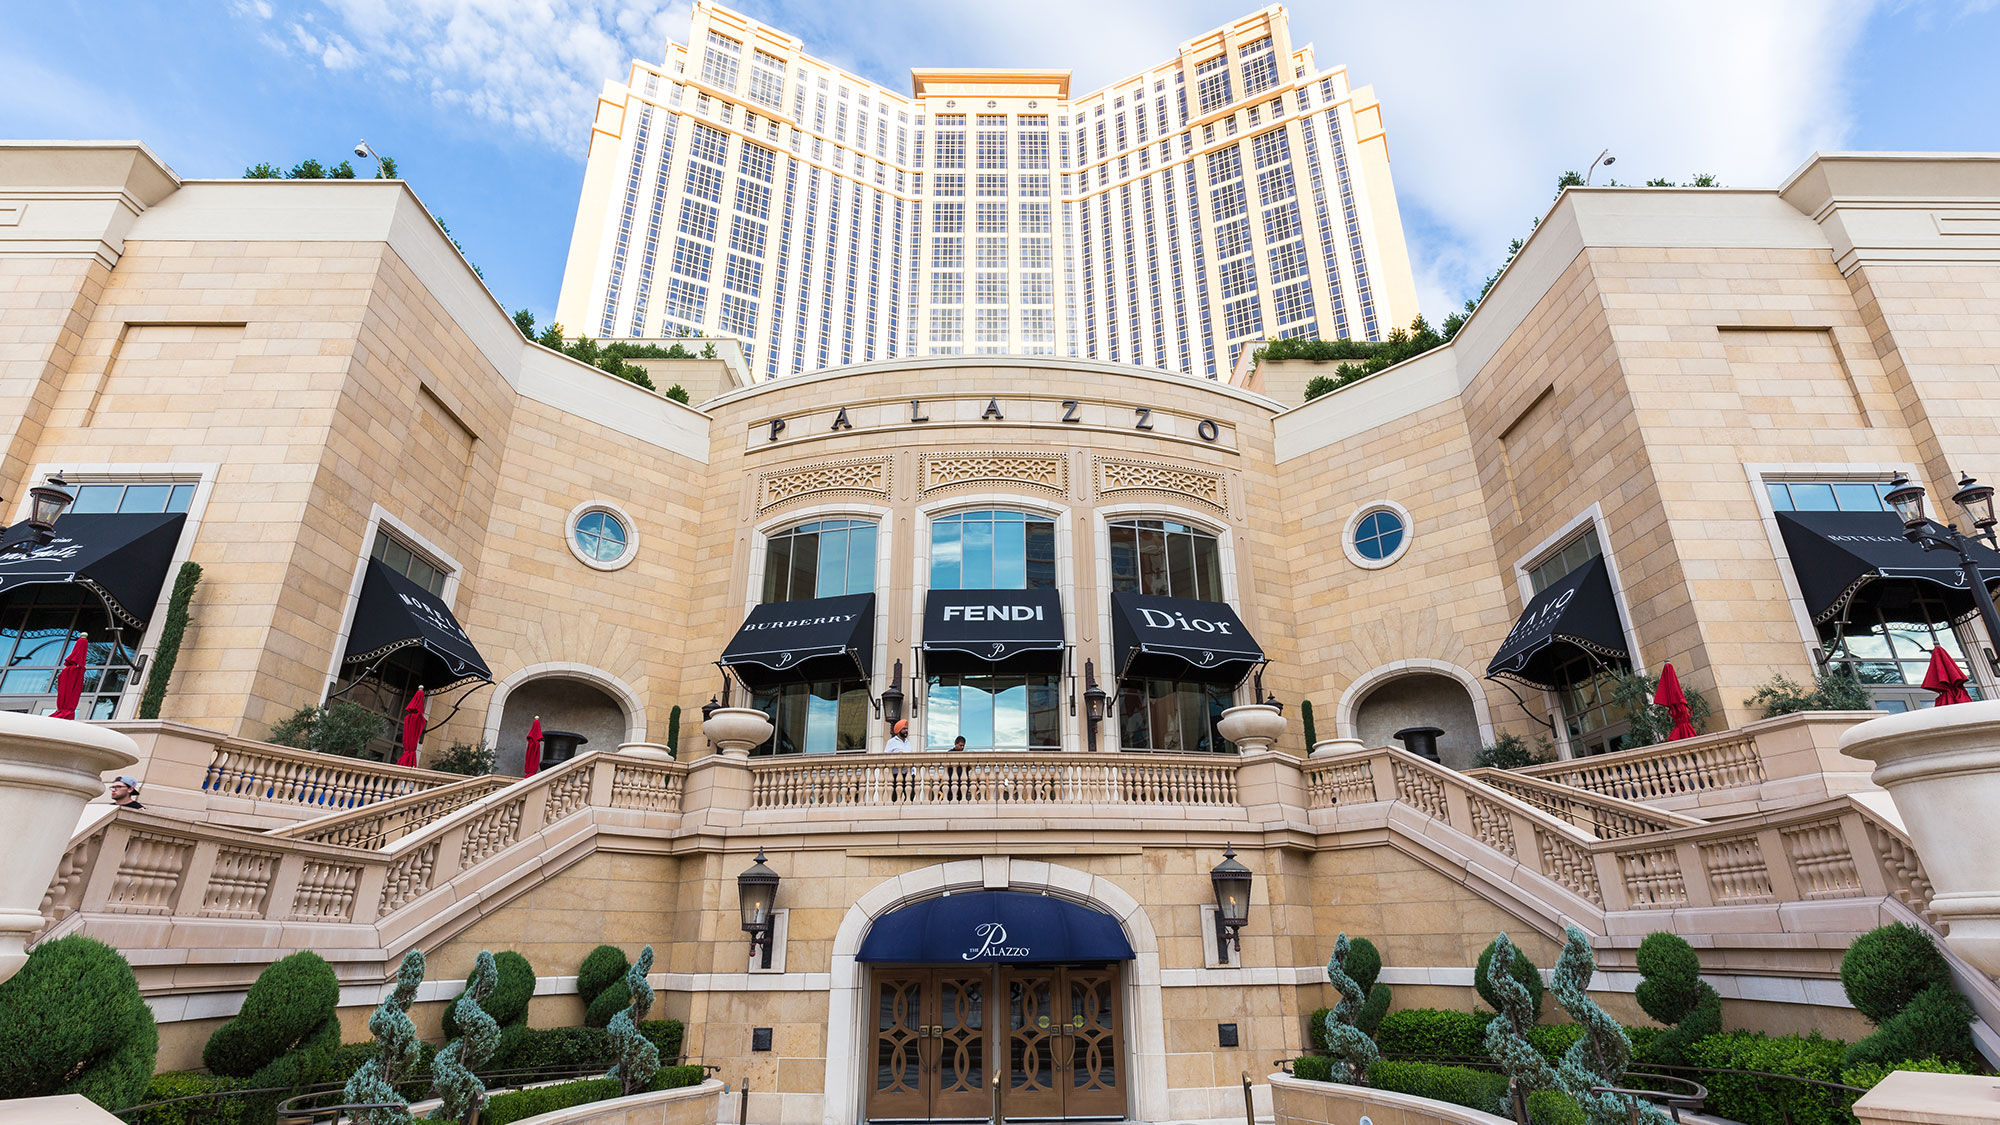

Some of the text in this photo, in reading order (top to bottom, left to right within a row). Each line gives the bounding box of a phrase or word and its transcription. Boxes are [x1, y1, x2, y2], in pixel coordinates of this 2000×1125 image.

[944, 84, 1040, 94] PALAZZO
[768, 397, 1219, 442] PALAZZO
[1828, 534, 1902, 543] BOTTEGA
[743, 613, 857, 632] BURBERRY
[943, 605, 1044, 621] FENDI
[1136, 608, 1232, 635] Dior
[1509, 588, 1575, 638] LAVO
[962, 923, 1030, 960] PALAZZO
